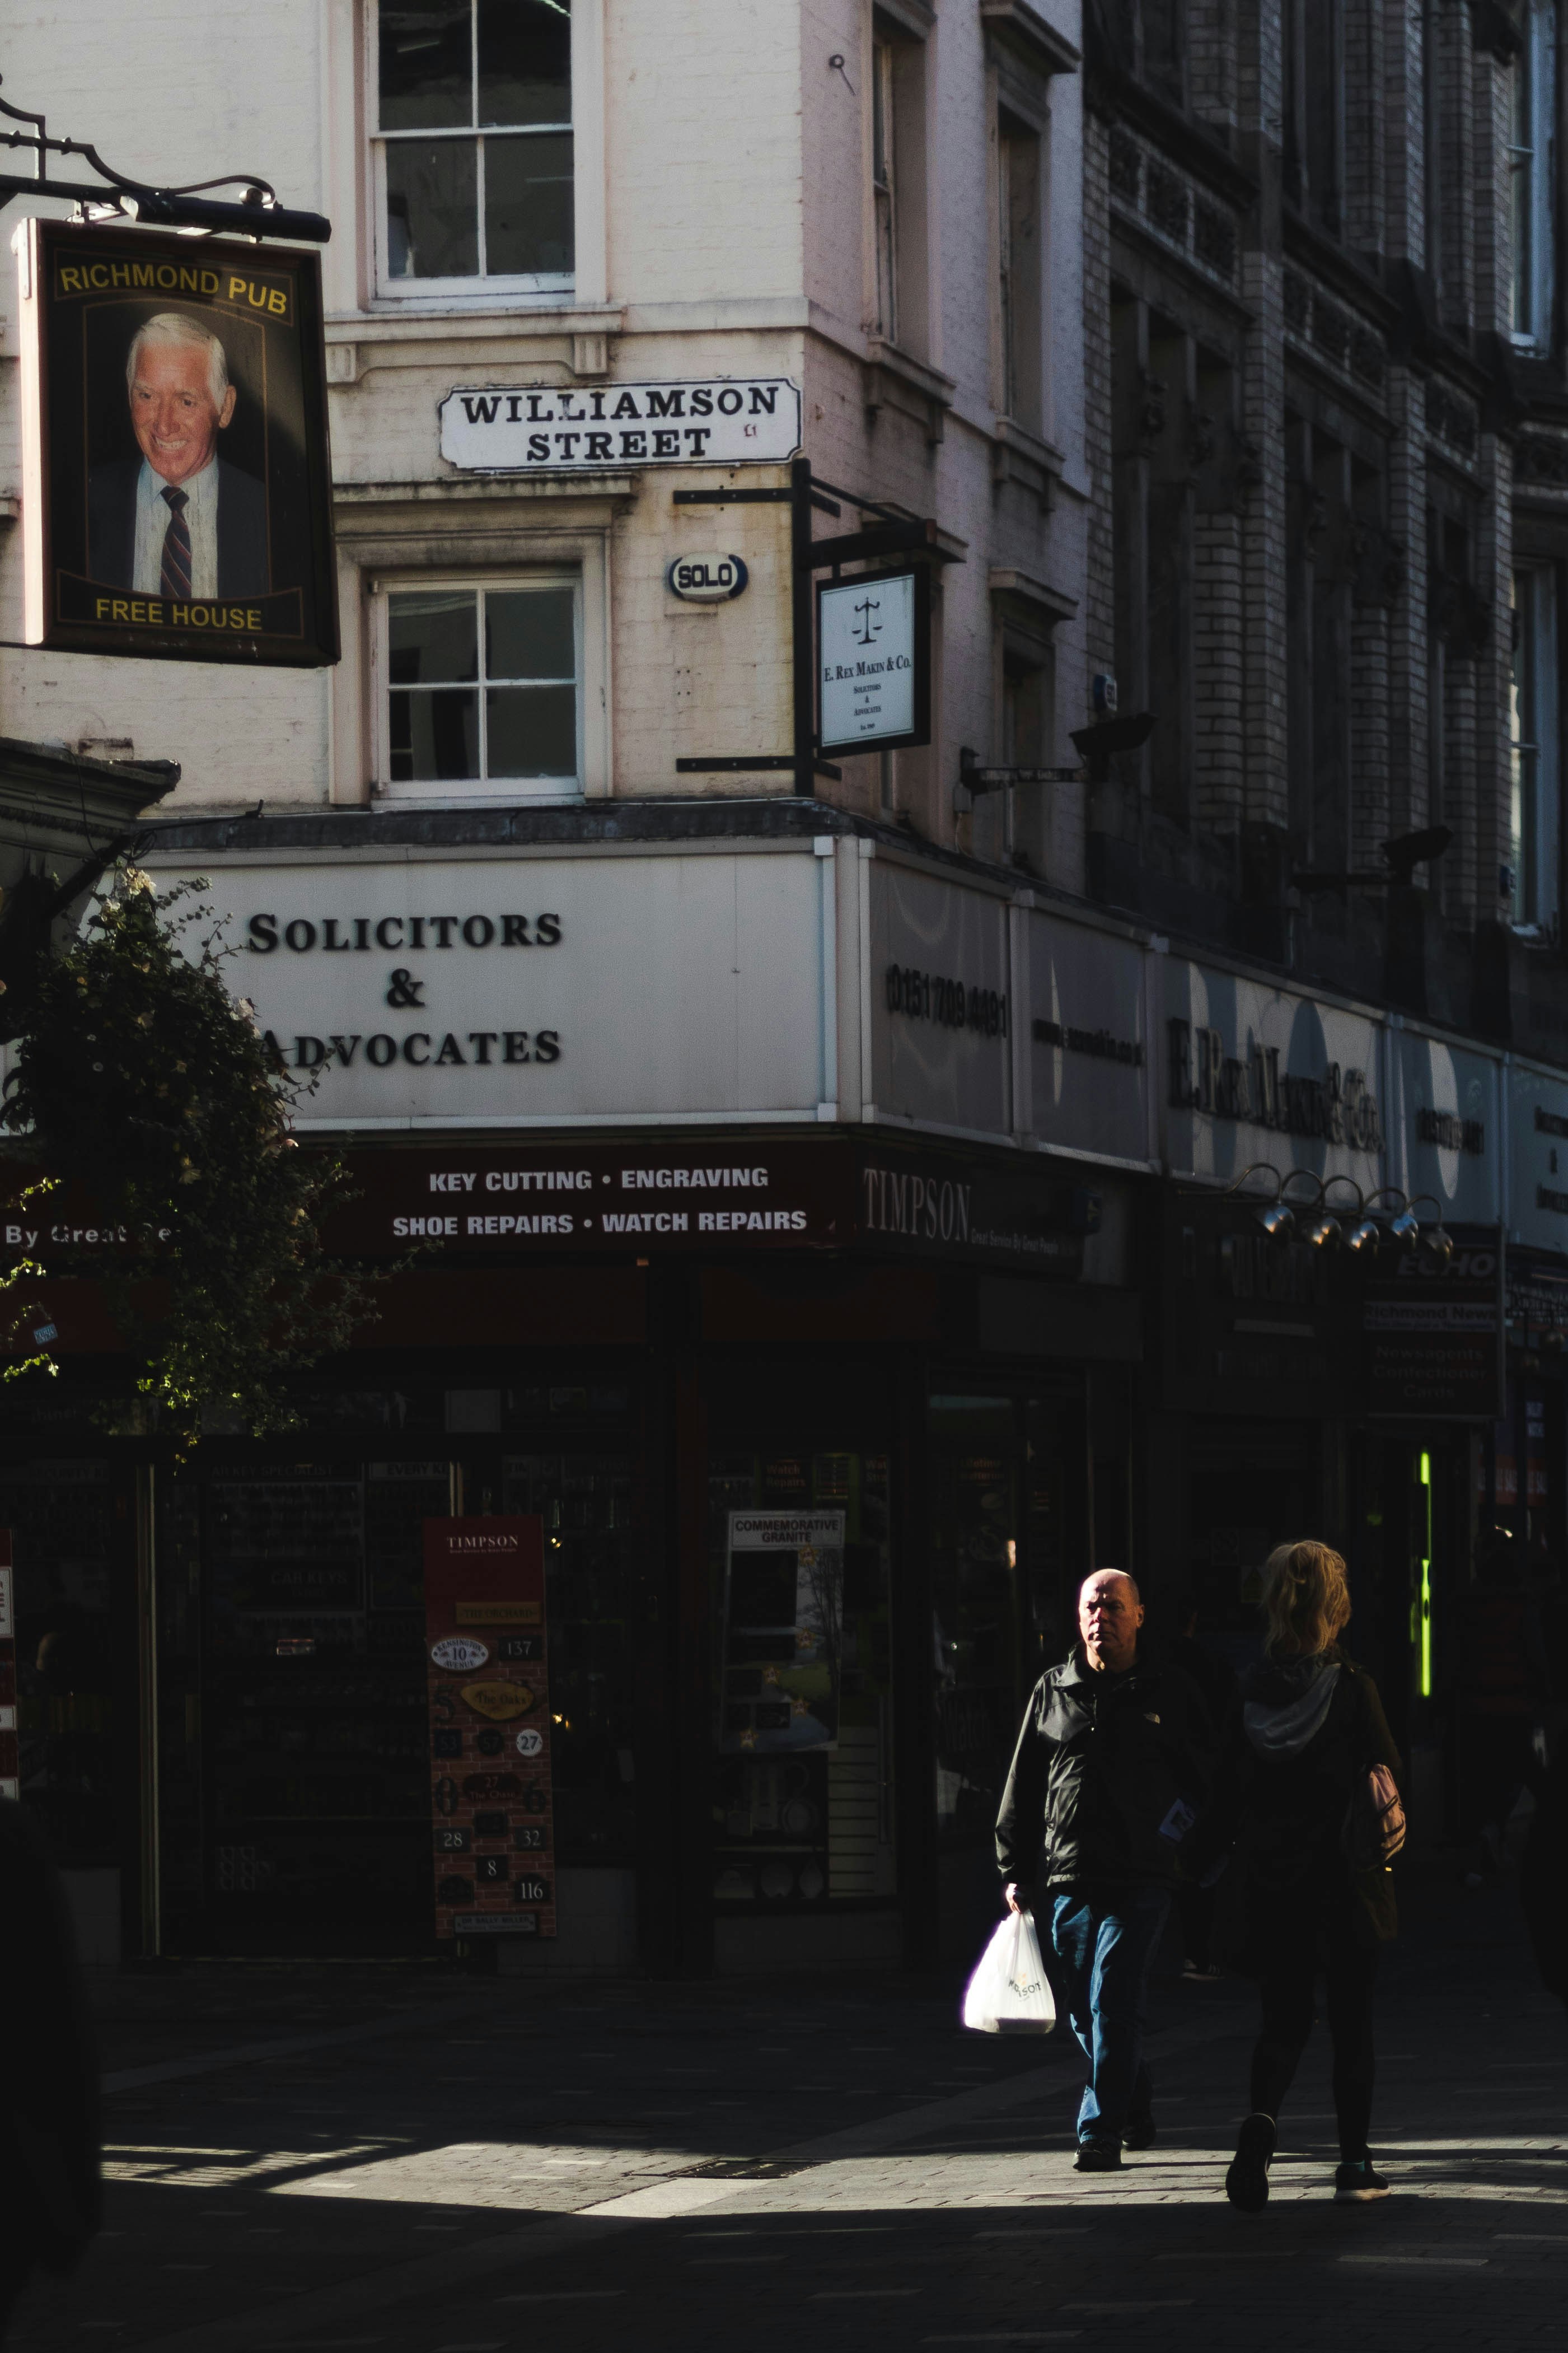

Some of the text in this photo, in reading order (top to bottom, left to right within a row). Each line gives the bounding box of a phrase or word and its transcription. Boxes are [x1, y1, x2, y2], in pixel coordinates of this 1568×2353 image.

[60, 263, 287, 315] RICHMOND PUB
[461, 386, 779, 423] WILLIAMSON
[527, 428, 711, 461] STREET
[678, 566, 732, 589] SOLO
[96, 598, 262, 631] FREE HOUSE
[824, 667, 834, 681] E.
[887, 657, 894, 671] &
[248, 913, 562, 953] SOLICITORS
[386, 968, 425, 1008] &
[886, 963, 930, 1019] 0151
[931, 977, 965, 1029] 709
[259, 1029, 560, 1070] ADVOCATES
[429, 1168, 769, 1192] KEY CUTTING ENGRAVING
[864, 1168, 971, 1243] TIMPSON
[971, 1227, 989, 1245] Great
[393, 1211, 807, 1236] SHOE REPAIRS WATCH REPAIRS
[6, 1226, 39, 1249] By
[1397, 1252, 1496, 1278] ECHO
[1365, 1305, 1496, 1319] Richmond News
[766, 1464, 801, 1475] Watch
[736, 1519, 839, 1532] COMMEMORATIVE
[447, 1535, 519, 1548] TIMPSON
[762, 1531, 812, 1544] GRANITE
[452, 1646, 467, 1661] 10
[507, 1640, 532, 1656] 137
[521, 1735, 539, 1750] 27
[484, 1776, 498, 1789] 27
[443, 1832, 464, 1848] 28
[523, 1829, 540, 1847] 32
[487, 1859, 498, 1877] 8
[521, 1882, 544, 1900] 116
